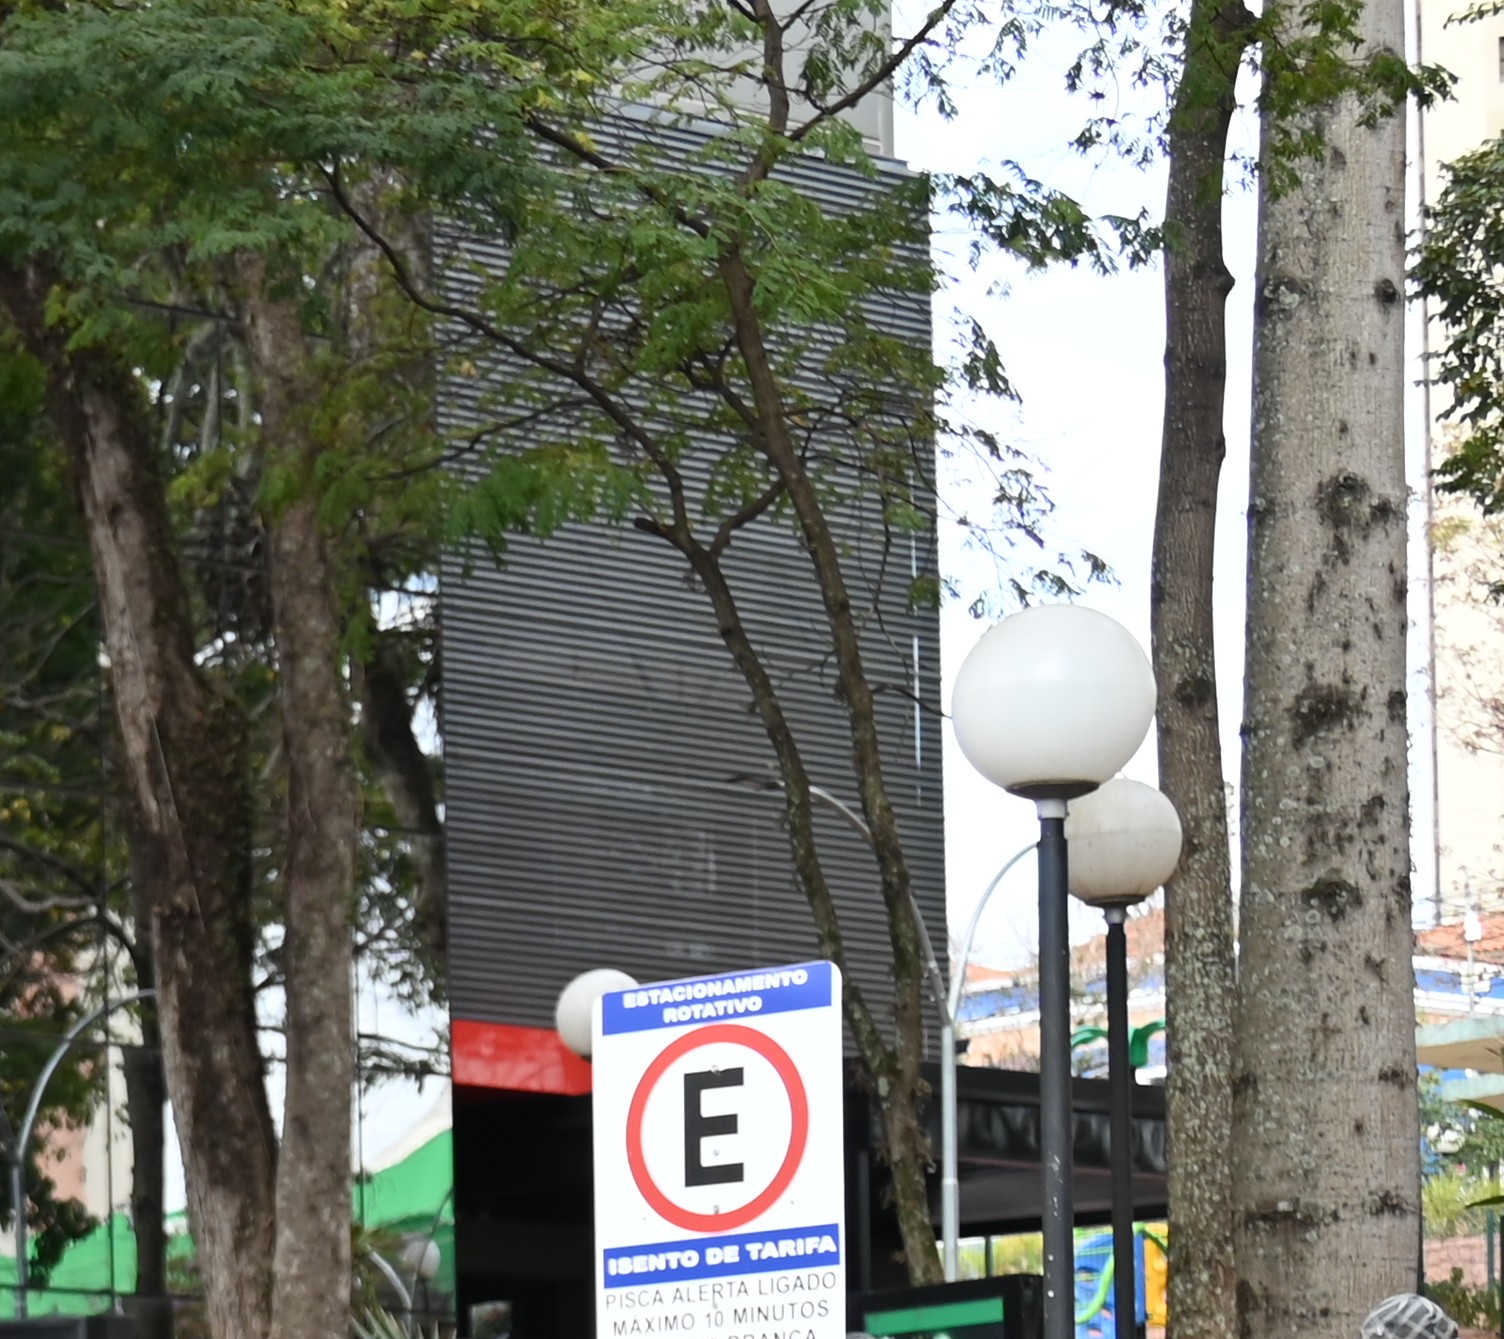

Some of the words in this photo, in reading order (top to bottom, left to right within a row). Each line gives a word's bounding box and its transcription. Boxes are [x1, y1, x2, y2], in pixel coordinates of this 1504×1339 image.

[622, 968, 809, 1010] ESTACIONAMENTO
[662, 996, 763, 1024] ROTATIVO
[684, 1066, 744, 1188] E
[607, 1250, 700, 1276] ISENTO
[705, 1245, 741, 1266] DE
[745, 1235, 837, 1262] TARIFA
[605, 1286, 664, 1311] PISCA
[672, 1279, 749, 1305] ALERTA
[758, 1271, 837, 1297] LIGADO
[705, 1310, 724, 1329] 10
[732, 1299, 830, 1326] MINUTOS
